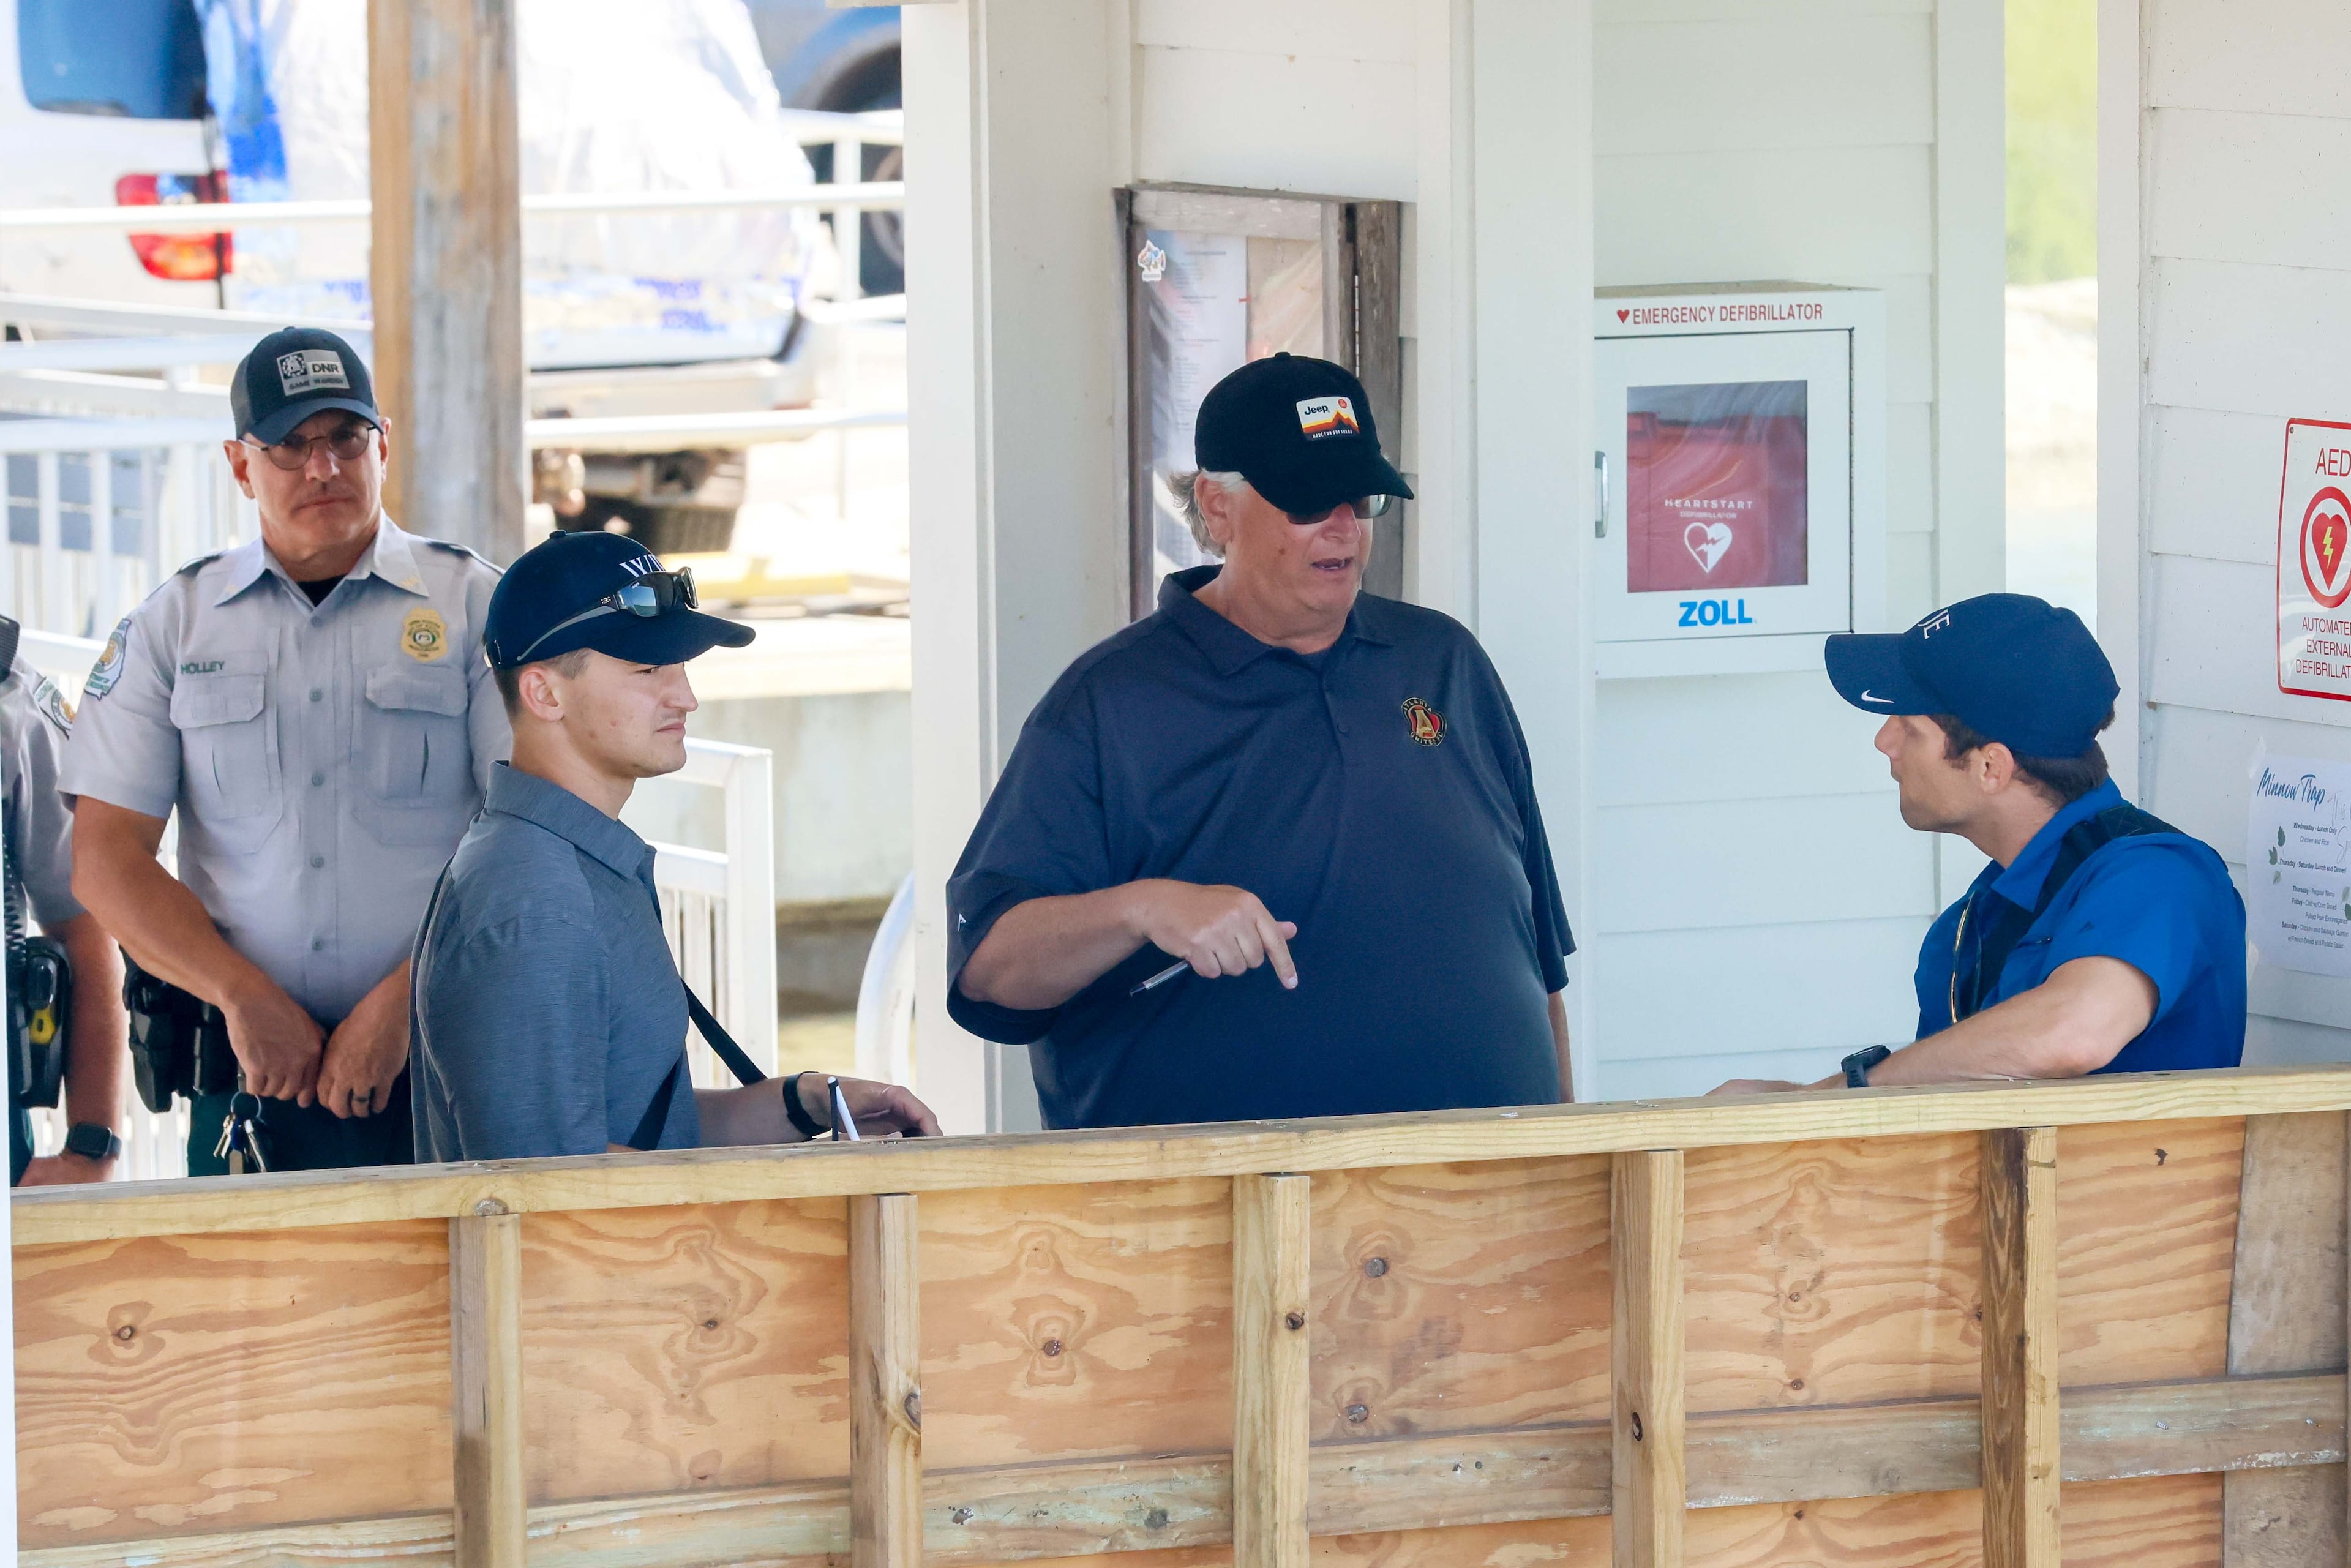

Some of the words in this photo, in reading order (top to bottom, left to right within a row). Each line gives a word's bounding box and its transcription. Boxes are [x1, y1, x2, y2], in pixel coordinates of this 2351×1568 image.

[1633, 306, 1715, 324] EMERGENCY
[1720, 304, 1823, 321] DEFIBRILLATOR
[312, 363, 339, 373] DNR
[1304, 405, 1329, 415] Jeep
[2315, 448, 2351, 476] AED
[1665, 499, 1753, 509] HEARTSTART
[1679, 599, 1753, 627] ZOLL
[2302, 617, 2351, 636] AUTOMATE
[181, 661, 225, 675] HOLLEY
[2257, 767, 2300, 801] Minnow
[2300, 774, 2325, 812] Trap
[2293, 822, 2314, 831] Wednesday
[2279, 858, 2296, 868] Thursday
[2298, 861, 2314, 870] Saturday
[2293, 885, 2309, 895] Thursday
[2292, 898, 2303, 906] Friday
[2282, 921, 2297, 931] Saturday
